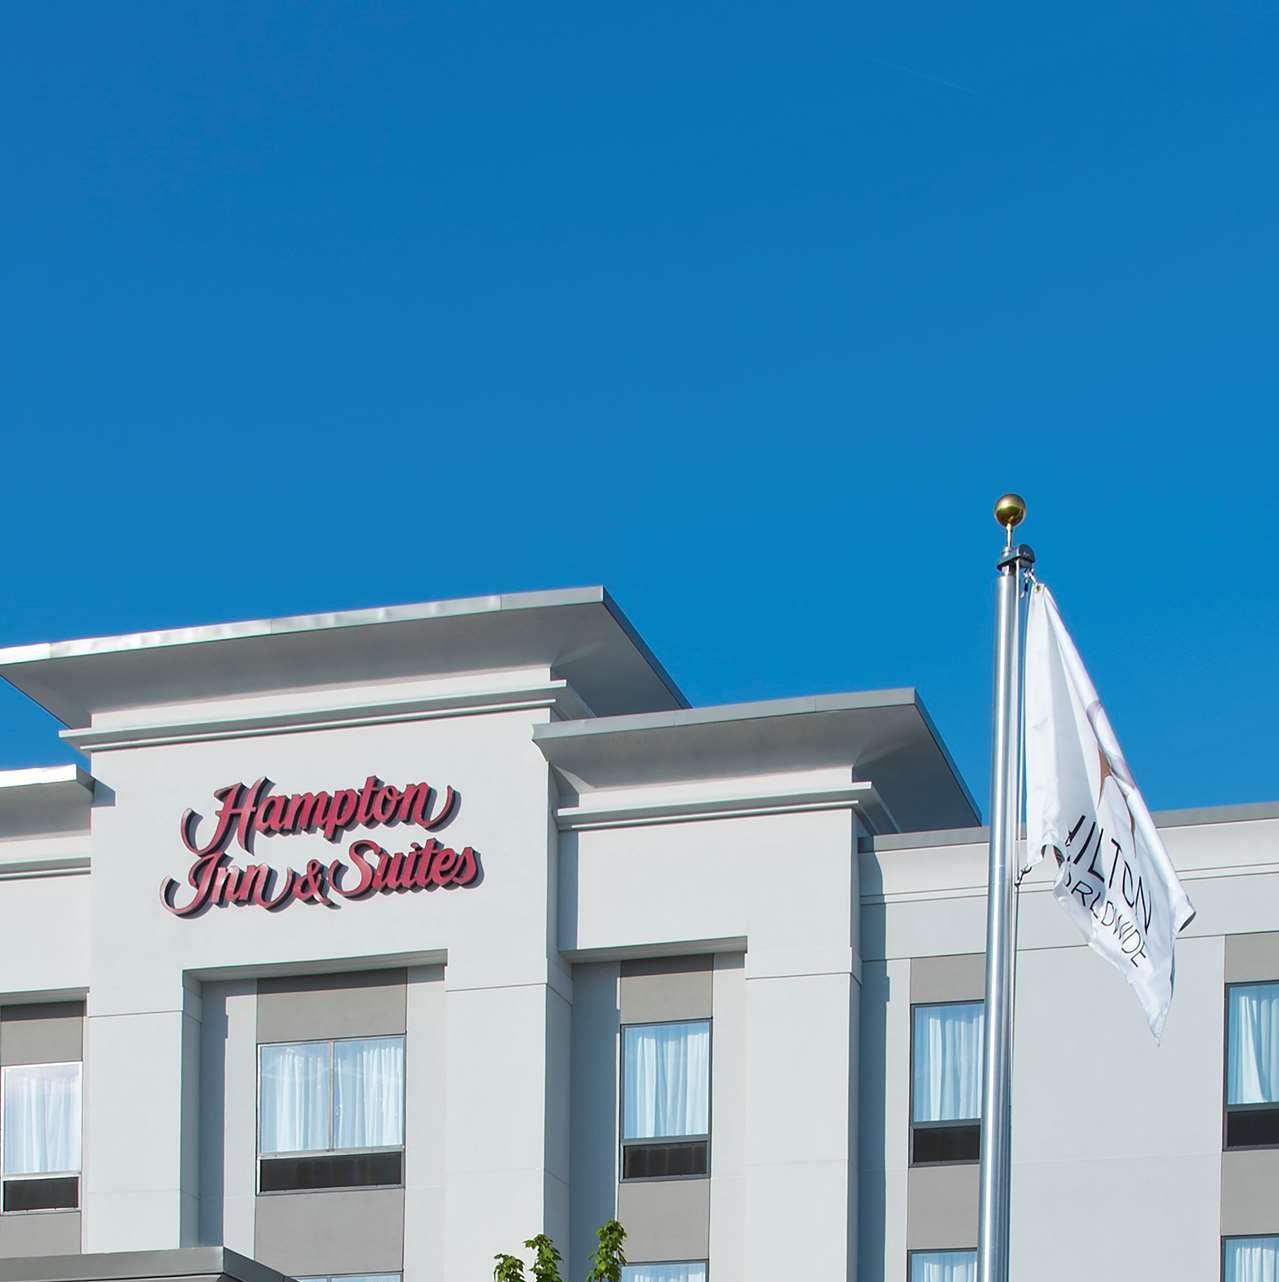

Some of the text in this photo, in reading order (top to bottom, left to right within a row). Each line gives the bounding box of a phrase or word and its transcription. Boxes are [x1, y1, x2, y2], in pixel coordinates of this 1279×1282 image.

[181, 775, 462, 857] Hampton
[160, 837, 484, 919] Inn & Suites
[1065, 871, 1146, 968] RLDWIDE
